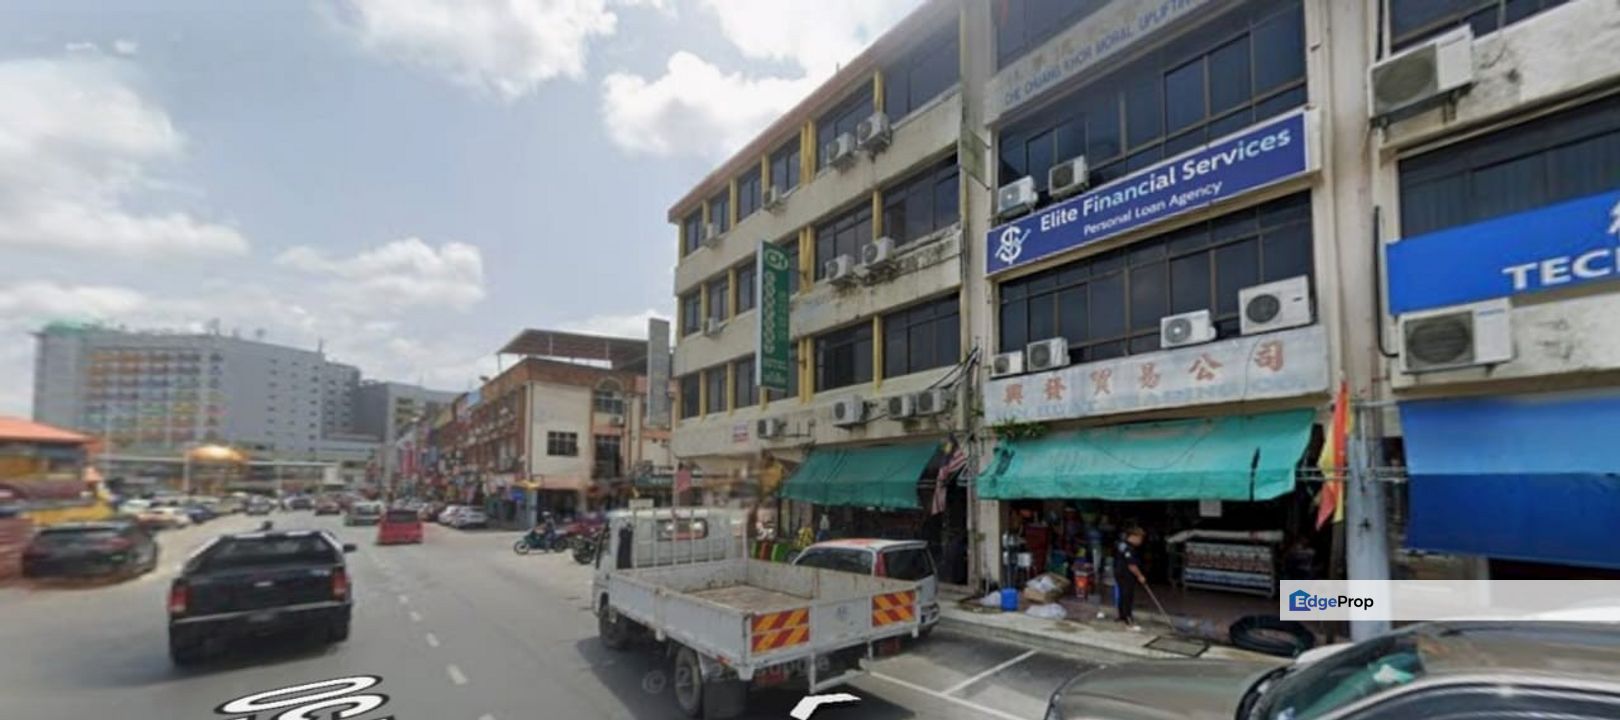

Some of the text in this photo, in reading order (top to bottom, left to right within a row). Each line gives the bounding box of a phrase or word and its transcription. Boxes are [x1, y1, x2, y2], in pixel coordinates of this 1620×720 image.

[1096, 26, 1135, 53] MORAL
[1040, 127, 1292, 232] Elite Financial Services
[1083, 180, 1223, 236] Personal Loan Agency
[1501, 246, 1620, 291] TEC
